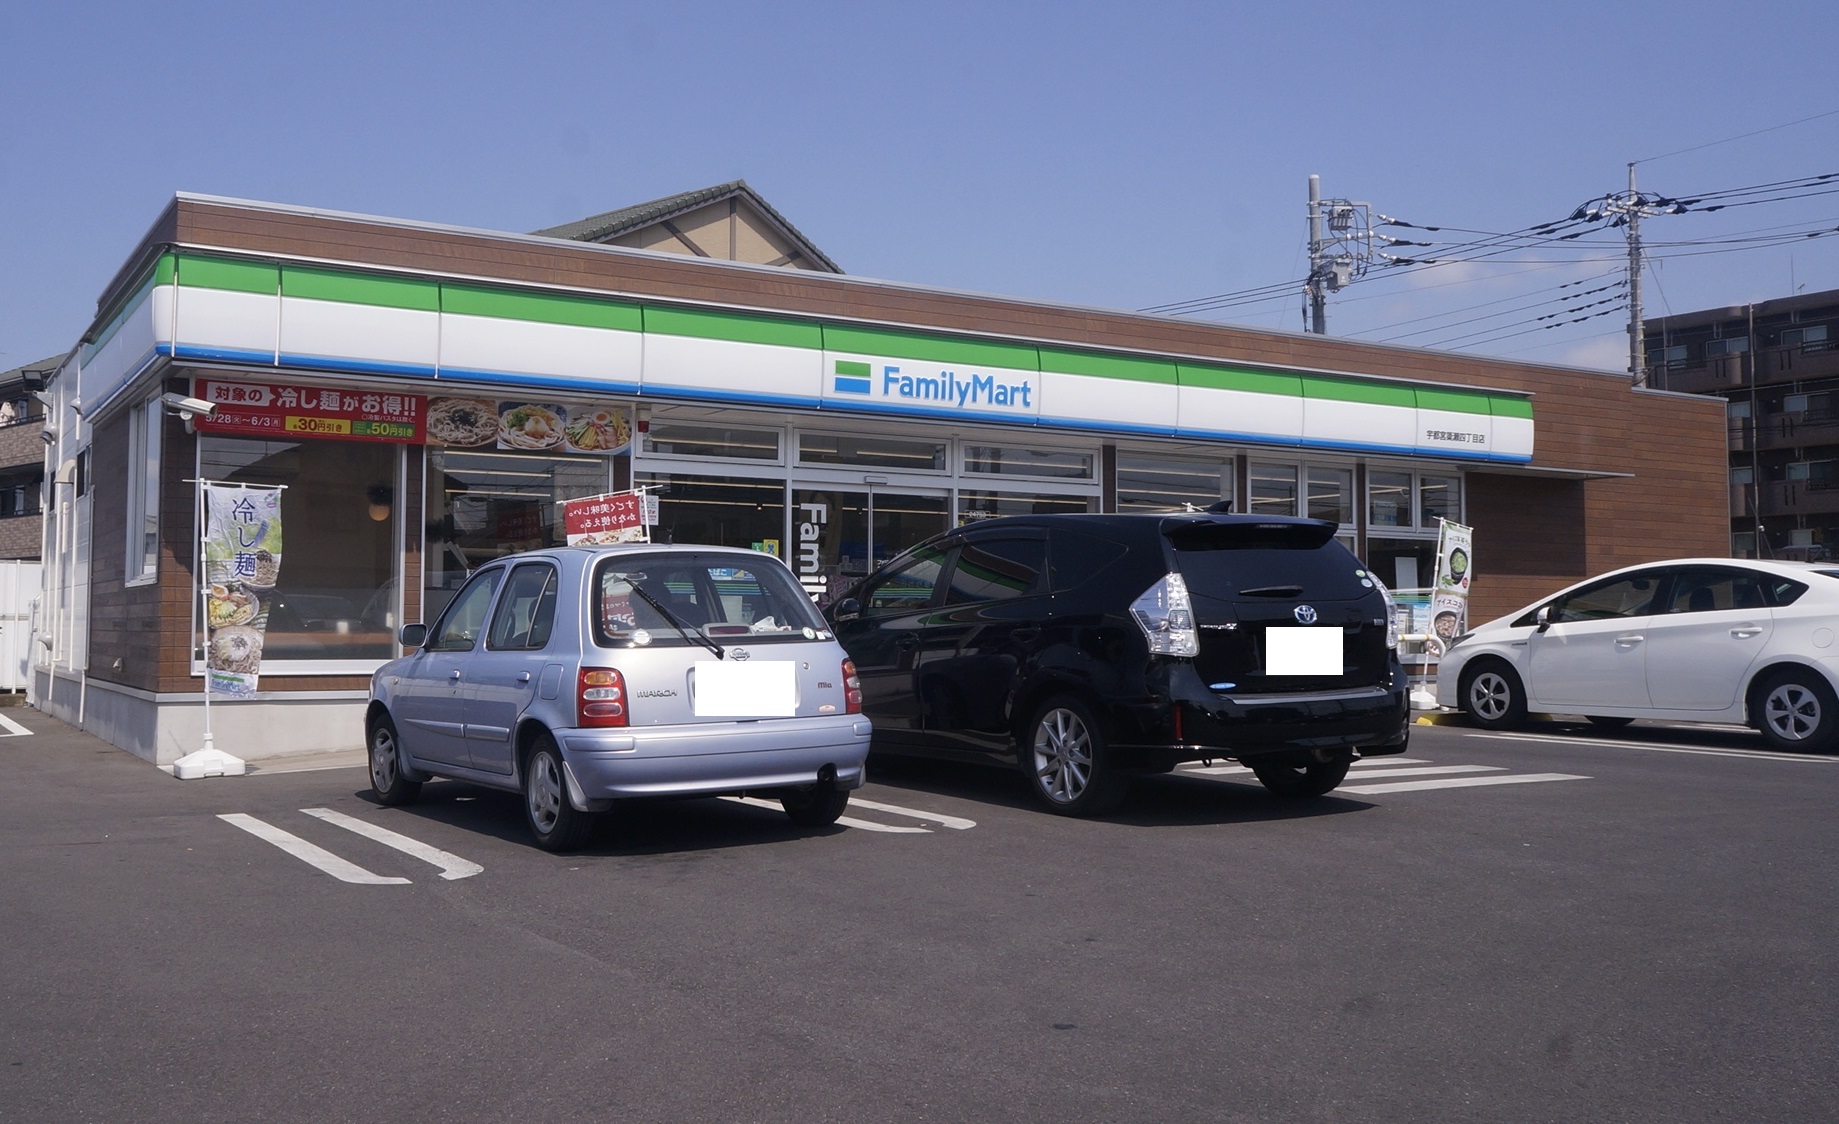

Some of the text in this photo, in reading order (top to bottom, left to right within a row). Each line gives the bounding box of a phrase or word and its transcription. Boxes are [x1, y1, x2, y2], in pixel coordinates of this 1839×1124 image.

[214, 386, 263, 403] 対象の
[883, 365, 1031, 409] FamilyMart
[231, 496, 257, 578] 冷し麺
[800, 502, 827, 604] Famil
[636, 689, 678, 698] MARCH
